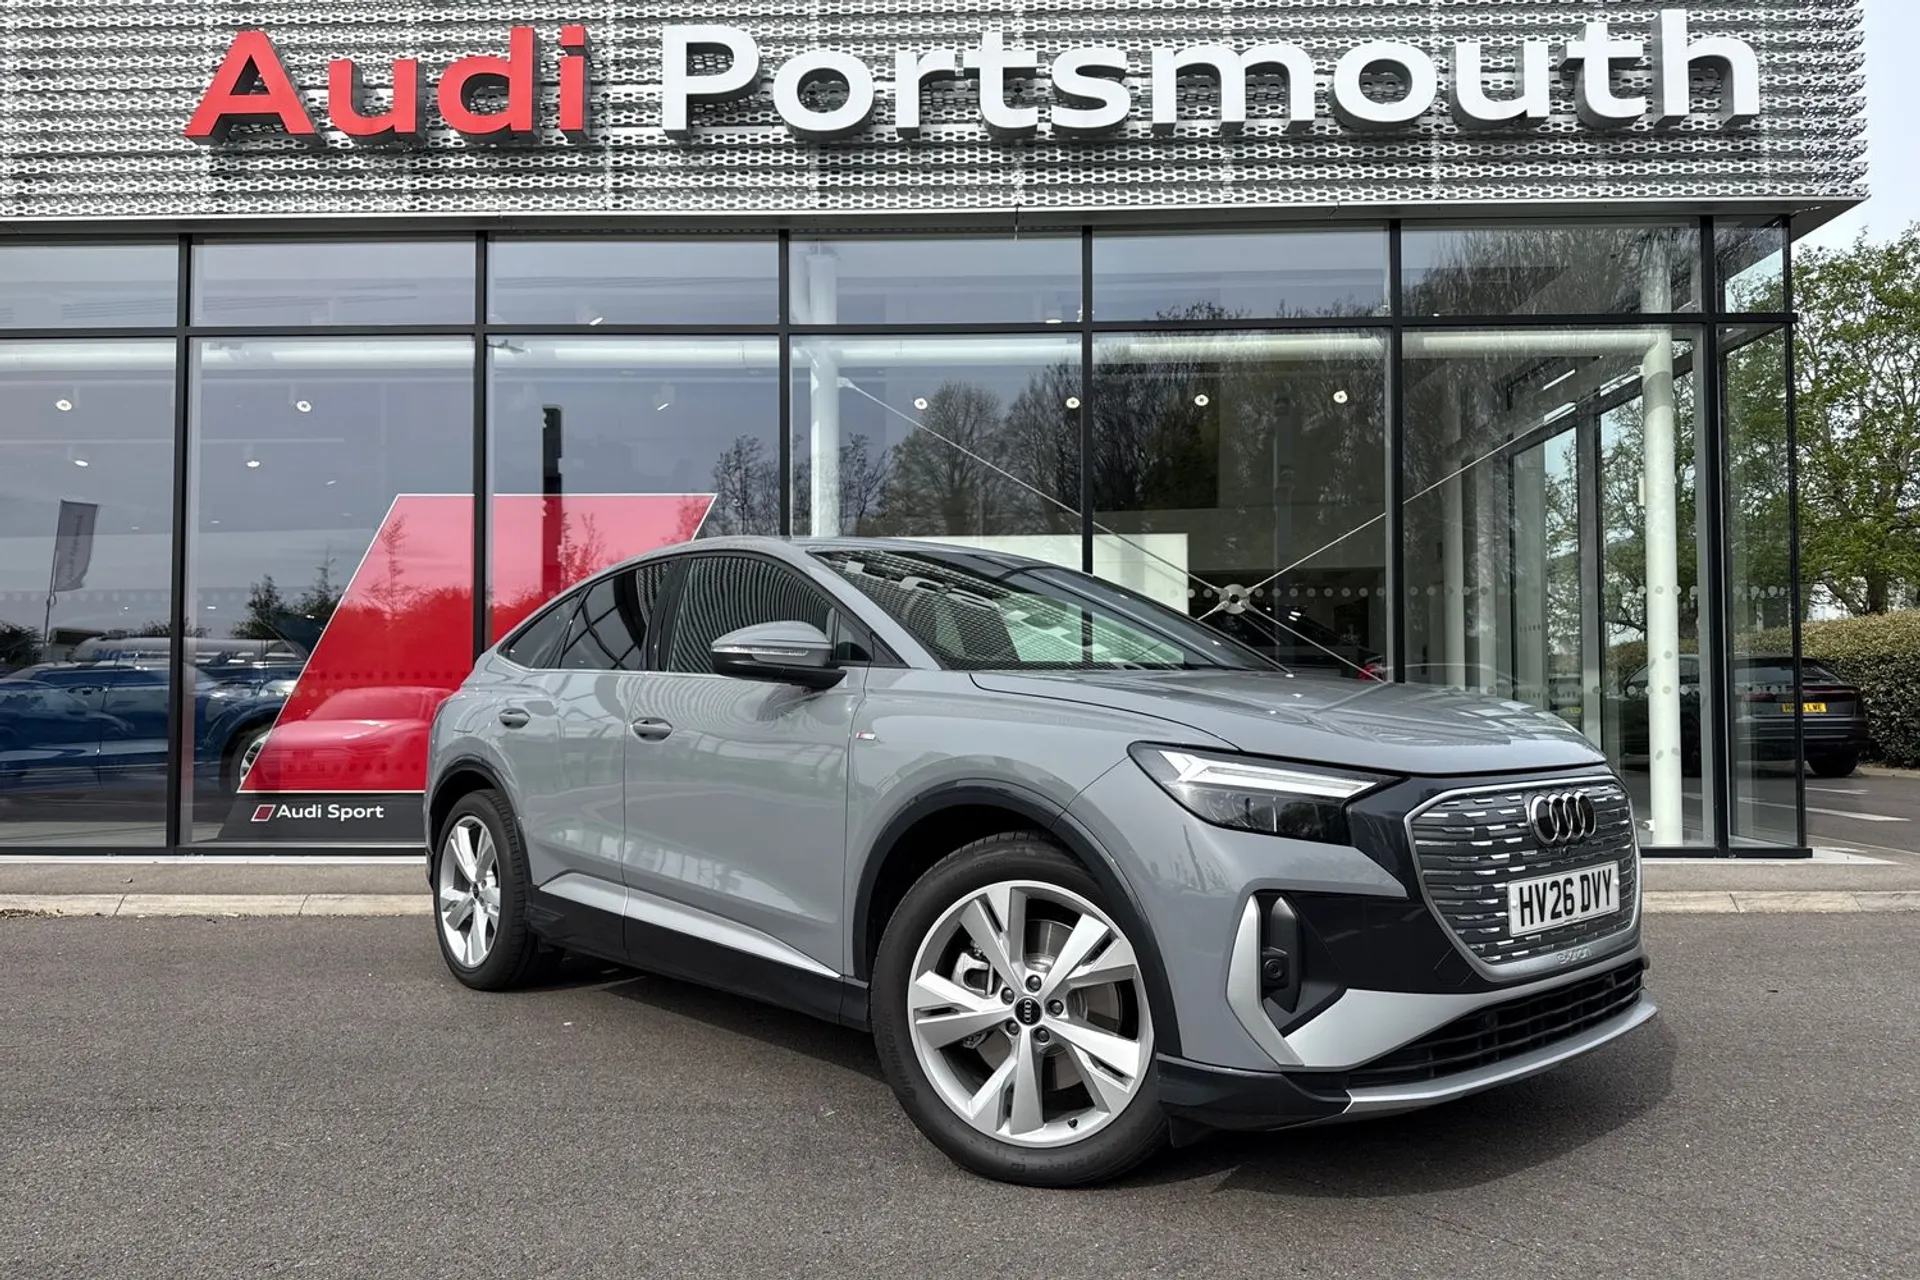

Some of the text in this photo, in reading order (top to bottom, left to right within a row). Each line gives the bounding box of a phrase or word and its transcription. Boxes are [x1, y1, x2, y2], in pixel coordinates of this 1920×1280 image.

[184, 8, 1761, 142] Audi Portsmouth
[276, 804, 384, 822] Audi Sport
[1519, 868, 1612, 927] HV26 DVY
